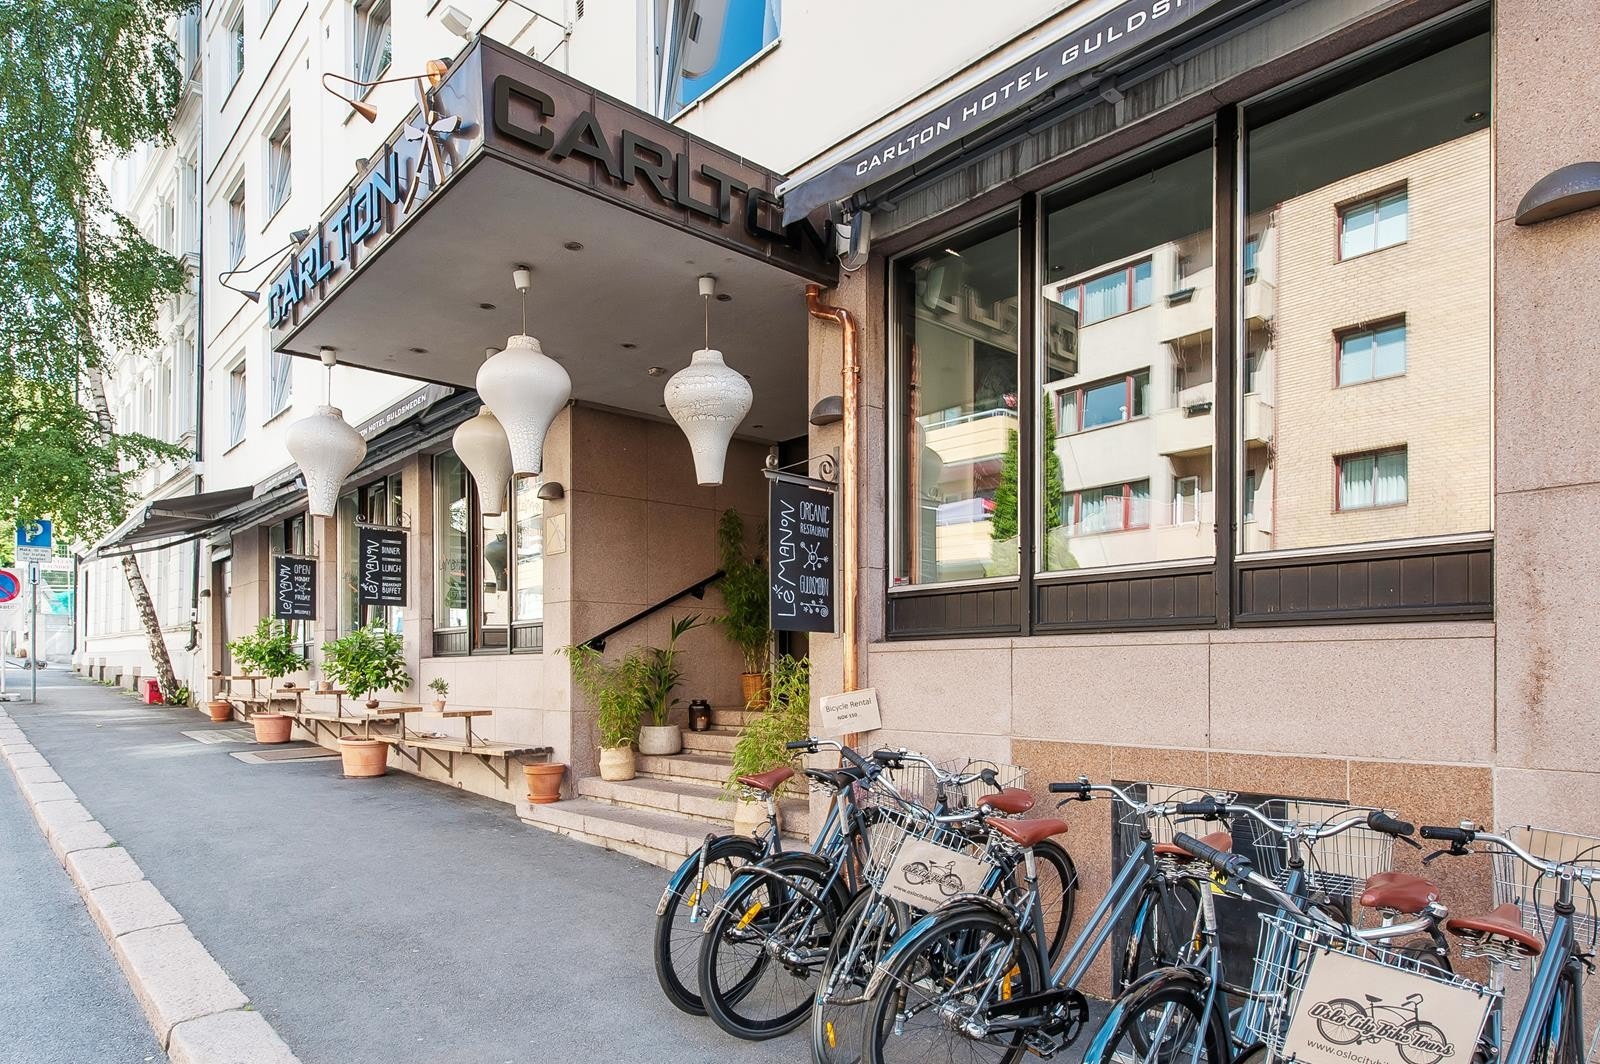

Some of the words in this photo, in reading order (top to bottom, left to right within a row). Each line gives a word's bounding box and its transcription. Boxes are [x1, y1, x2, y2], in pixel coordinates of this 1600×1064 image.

[855, 116, 951, 177] CARLTON
[962, 66, 1049, 121] HOTEL
[1061, 0, 1184, 66] GULDS
[268, 151, 399, 329] CARLTON
[368, 418, 386, 432] HOTEL
[386, 393, 427, 422] GULDSMEDEN
[799, 500, 830, 524] ORGANIC
[799, 522, 829, 539] RESTAURANT
[381, 546, 401, 555] DINNER
[294, 564, 311, 575] OPEN
[381, 564, 402, 573] LUNCH
[381, 586, 402, 595] BUFFET
[825, 702, 849, 713] Bicycle
[849, 697, 872, 708] Rental
[1310, 1002, 1345, 1025] Oslo
[1349, 1015, 1376, 1036] City
[1376, 1022, 1411, 1043] Bike
[1410, 1032, 1454, 1056] Tours
